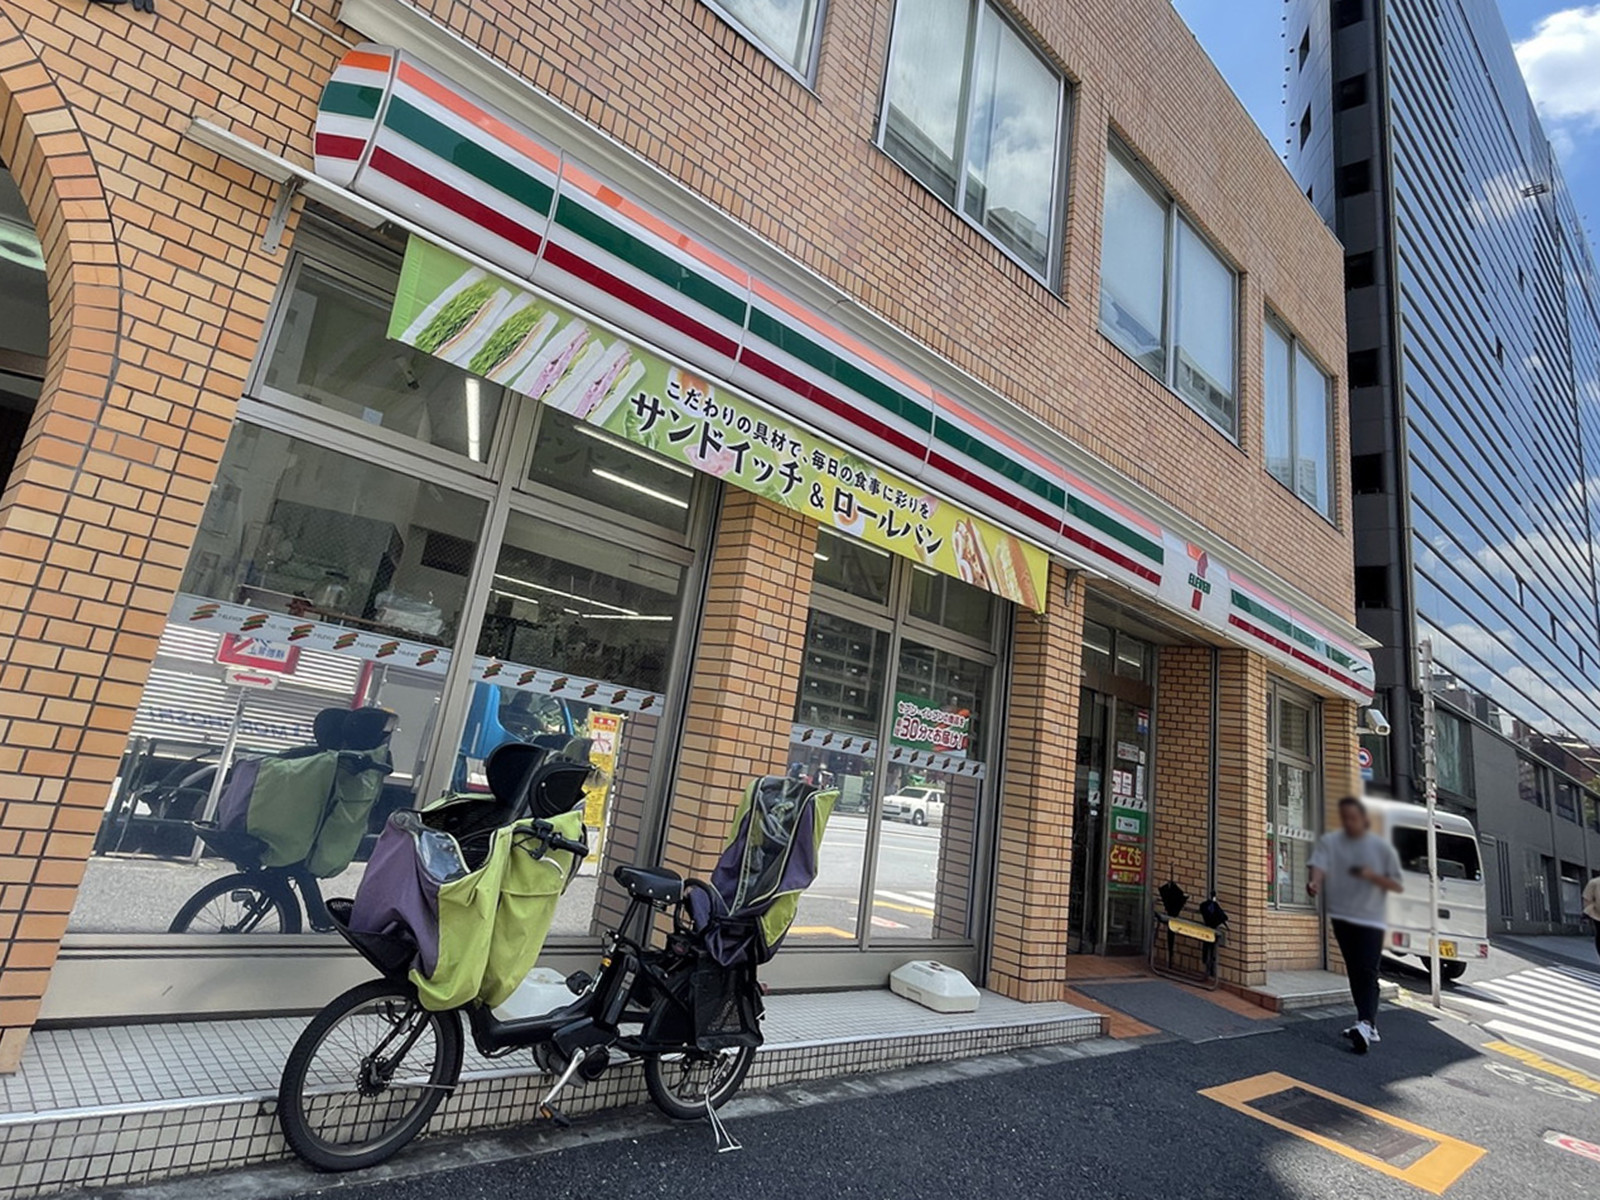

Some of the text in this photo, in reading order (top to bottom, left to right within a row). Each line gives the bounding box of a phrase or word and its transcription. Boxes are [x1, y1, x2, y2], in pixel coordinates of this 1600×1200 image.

[630, 392, 803, 494] サンドイッチ
[810, 482, 825, 509] &
[833, 487, 944, 554] ロールパン
[667, 382, 930, 520] こだわりの具材で、毎日の食事に彩りを
